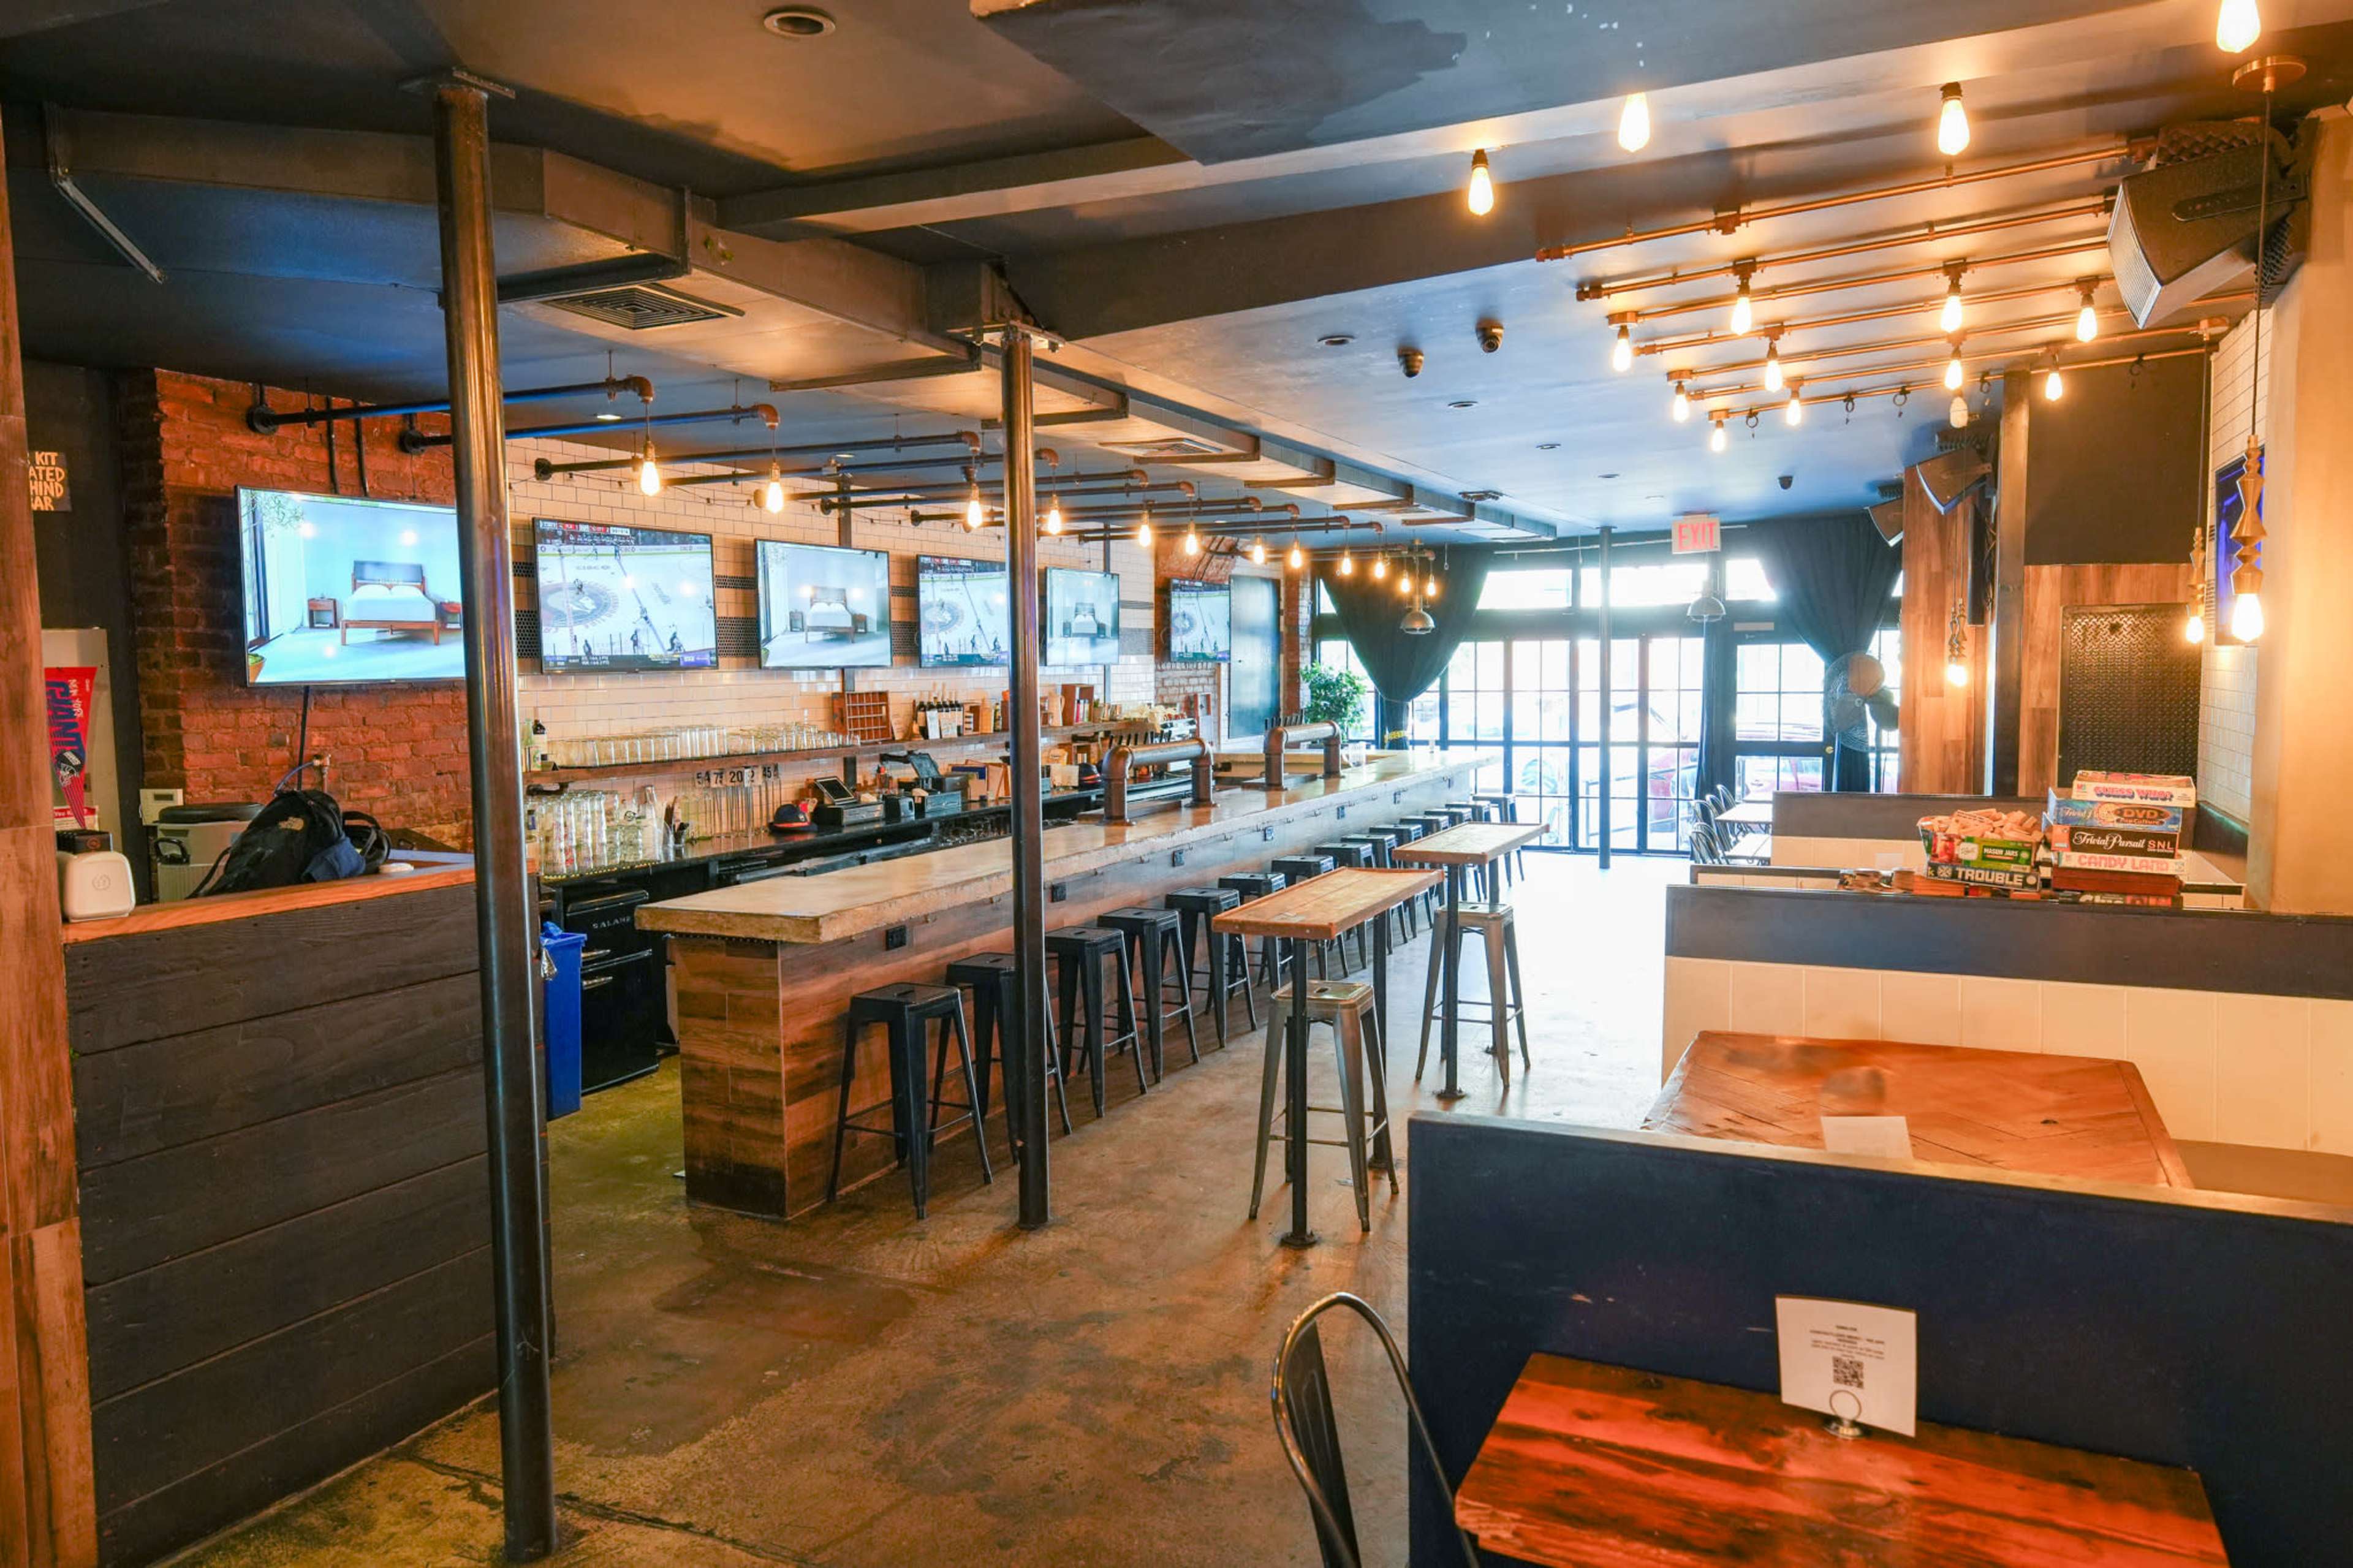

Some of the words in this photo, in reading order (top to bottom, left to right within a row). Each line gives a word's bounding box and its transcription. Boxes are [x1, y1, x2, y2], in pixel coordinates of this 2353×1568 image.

[35, 451, 59, 466] KIT
[1678, 522, 1716, 550] EXIT
[46, 681, 86, 759] GIANT
[729, 770, 743, 784] 20
[2094, 786, 2135, 799] GUESS
[2124, 808, 2159, 819] DVD
[2072, 831, 2109, 845] Trivial
[2104, 833, 2146, 850] Pursuit
[2148, 839, 2174, 849] SNL
[2078, 854, 2128, 868] CANDY
[2131, 858, 2169, 872] LAND
[1956, 868, 2023, 886] TROUBLE
